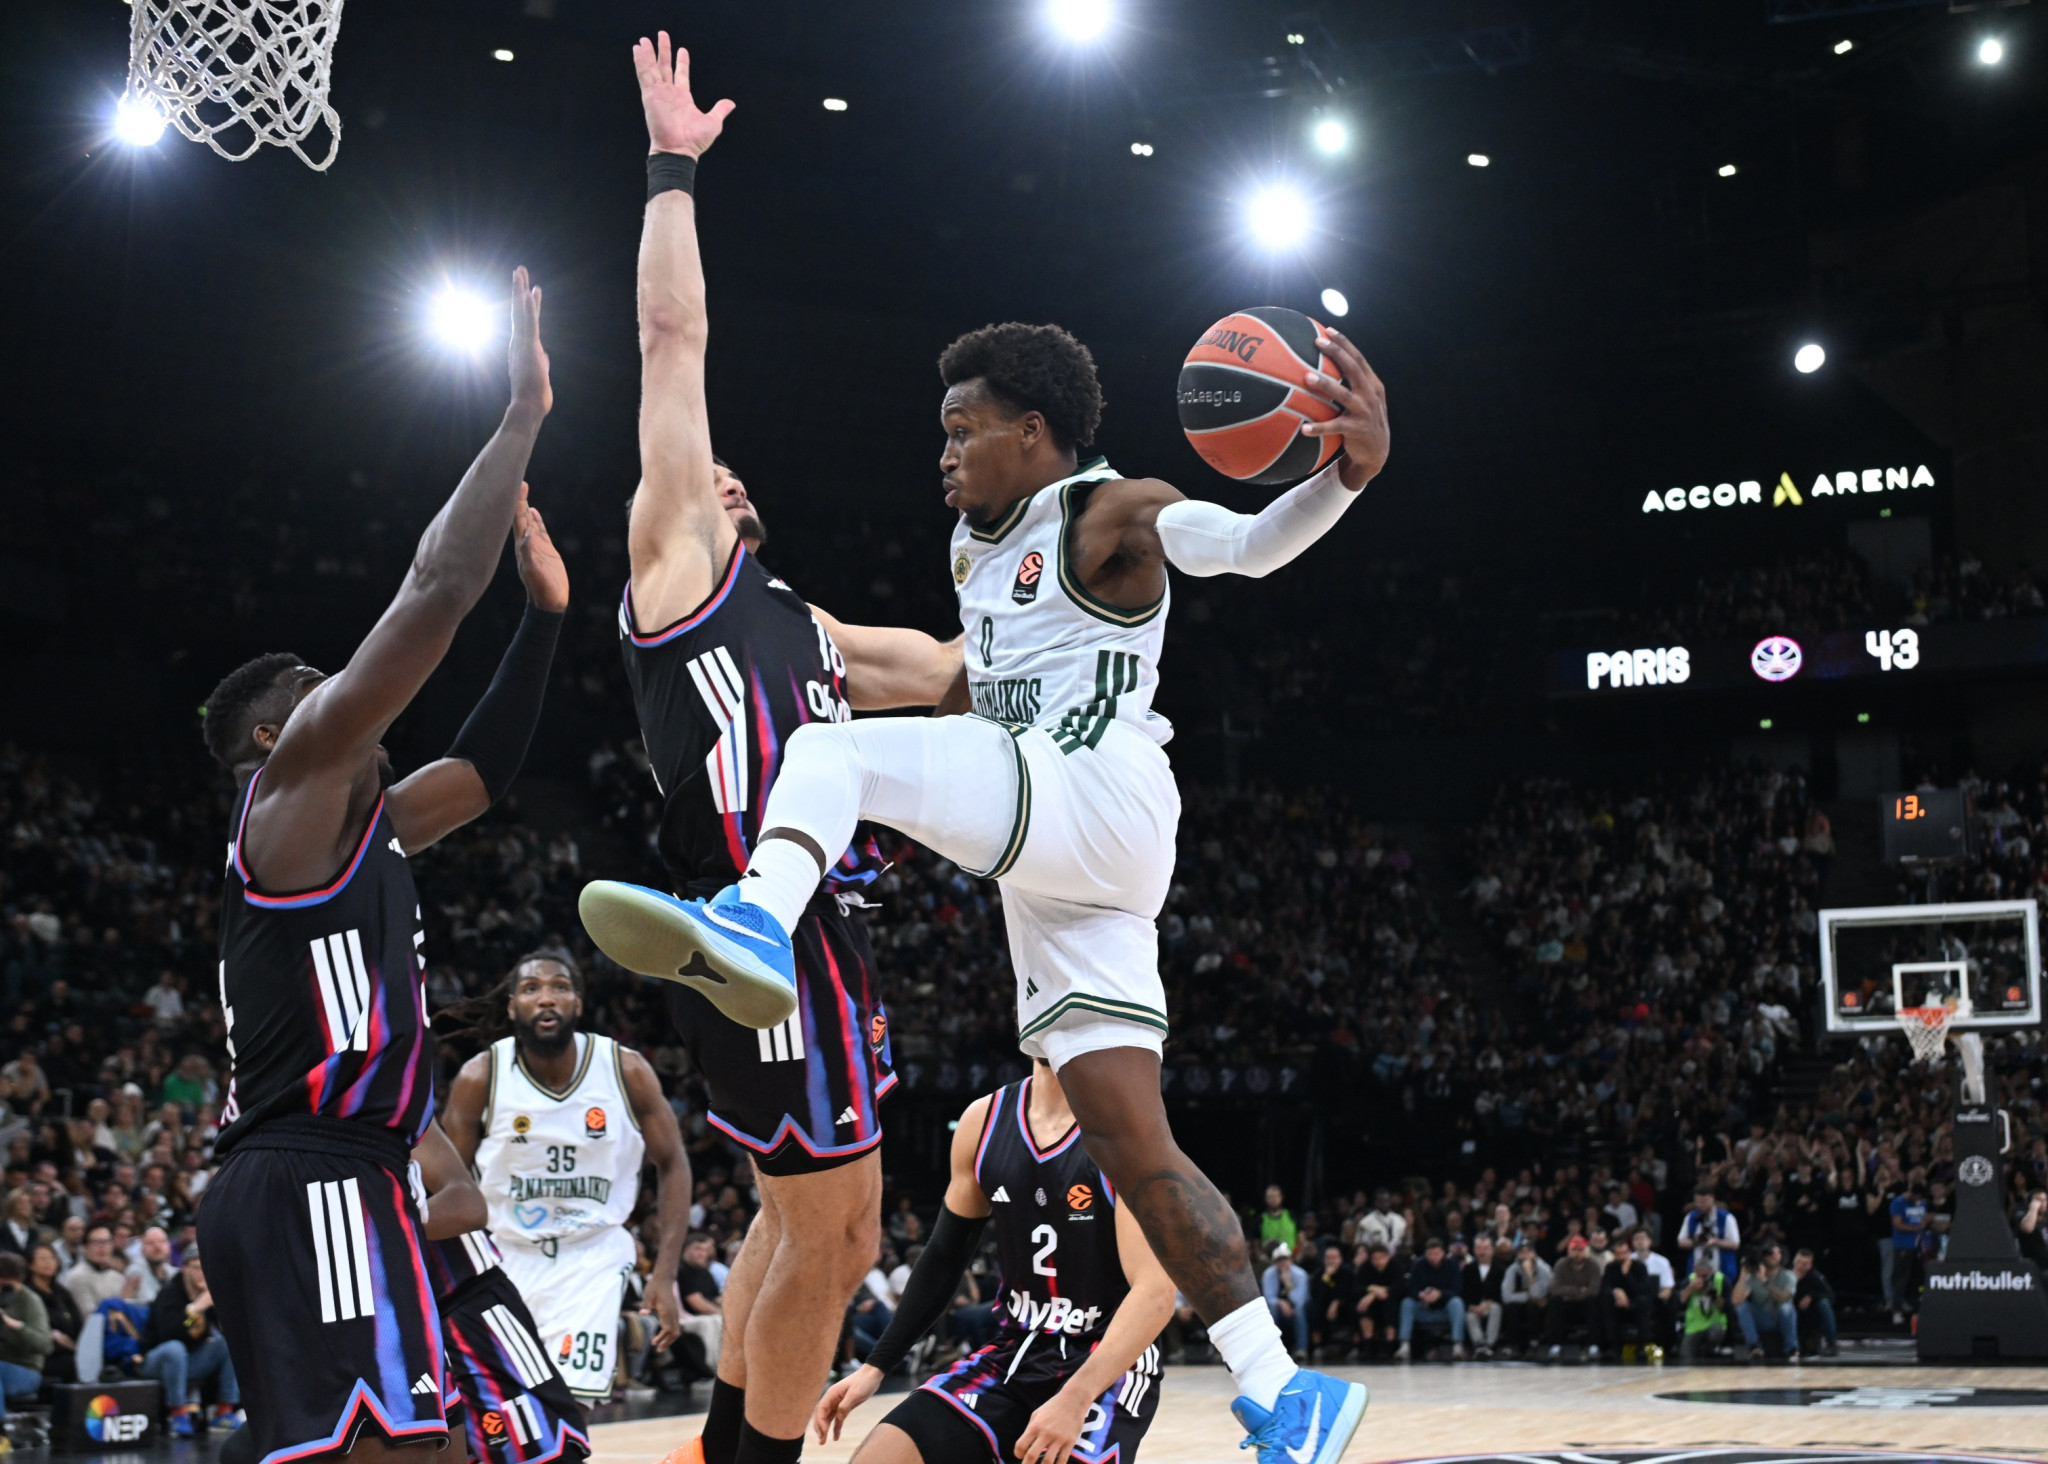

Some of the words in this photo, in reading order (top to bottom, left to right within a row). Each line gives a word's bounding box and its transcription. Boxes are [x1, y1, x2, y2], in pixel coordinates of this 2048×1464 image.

[1642, 480, 1762, 513] ACCOR
[1811, 465, 1935, 498] ARENA
[980, 615, 994, 668] 0
[1865, 628, 1920, 672] 43
[1587, 646, 1691, 690] PARIS
[546, 1145, 577, 1173] 35
[1031, 1223, 1058, 1278] 2
[1929, 1270, 2032, 1291] nutribullet
[572, 1331, 607, 1372] 35
[103, 1414, 149, 1442] NEP
